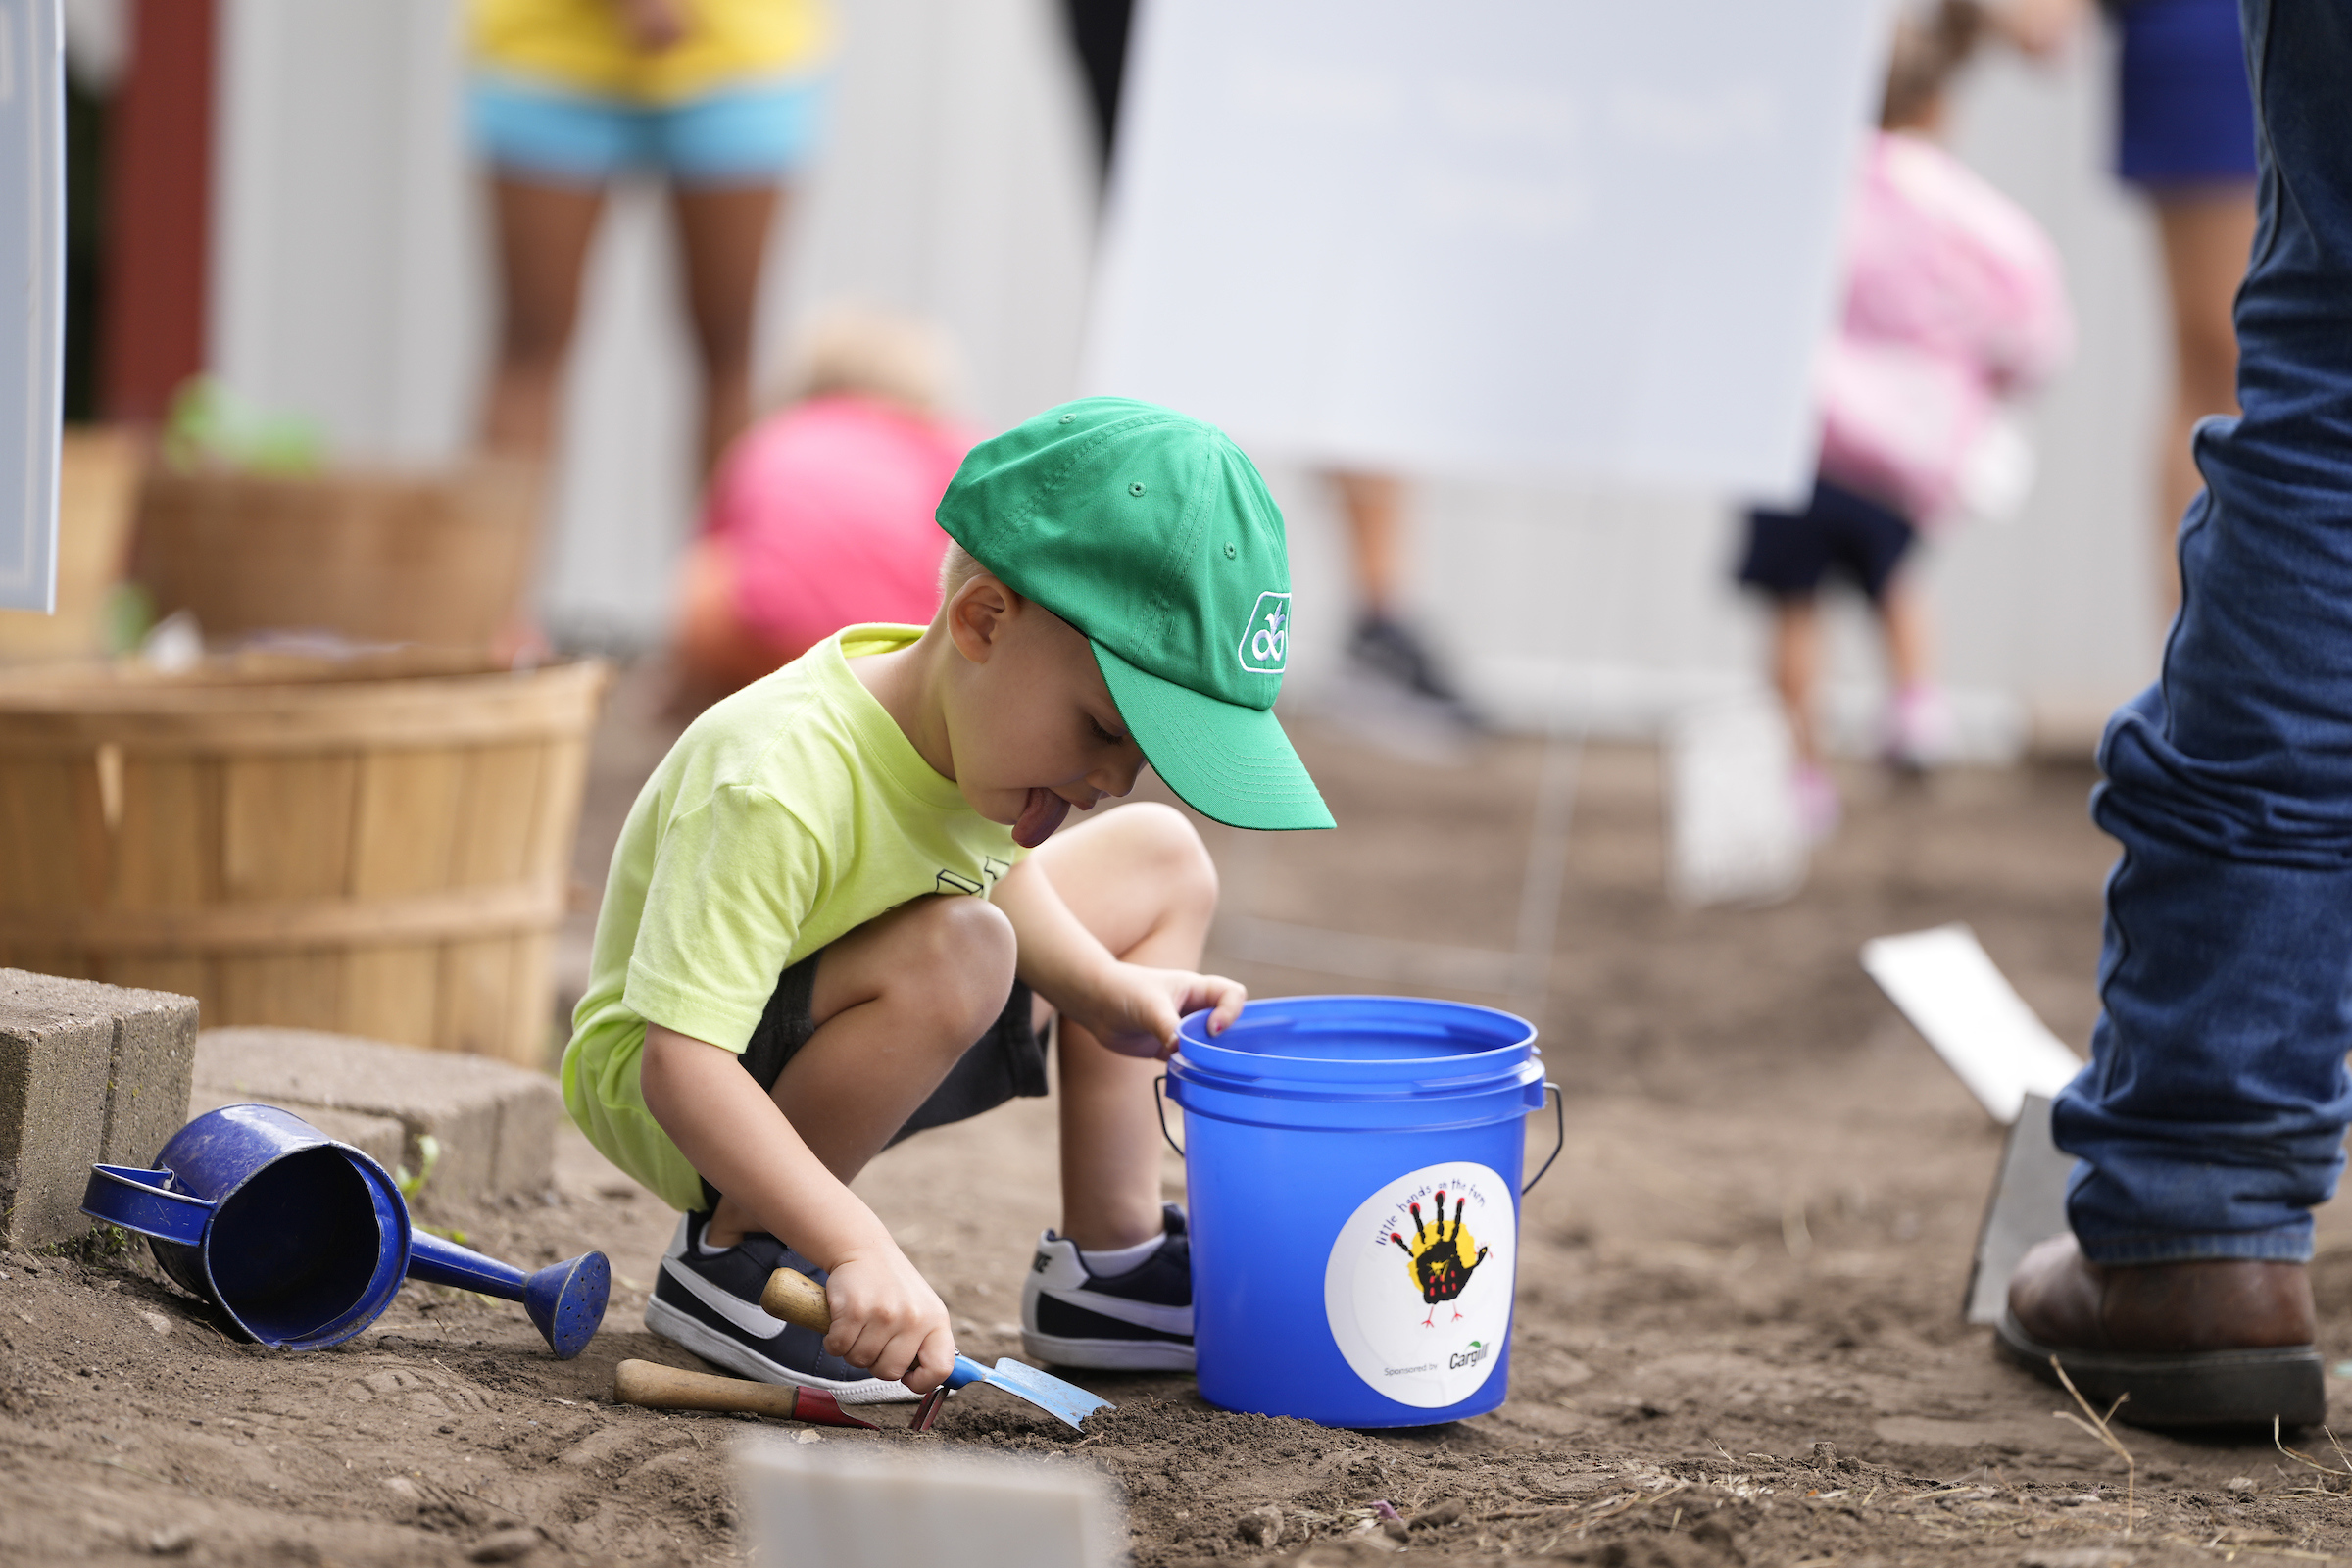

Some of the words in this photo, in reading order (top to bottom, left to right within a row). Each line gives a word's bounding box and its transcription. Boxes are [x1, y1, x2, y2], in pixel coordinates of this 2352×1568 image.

[1376, 1215, 1397, 1246] little
[1396, 1186, 1432, 1212] hands
[1451, 1178, 1466, 1191] the
[1468, 1184, 1486, 1207] farm
[1449, 1343, 1490, 1370] Cargill
[1384, 1364, 1427, 1377] Sponsored
